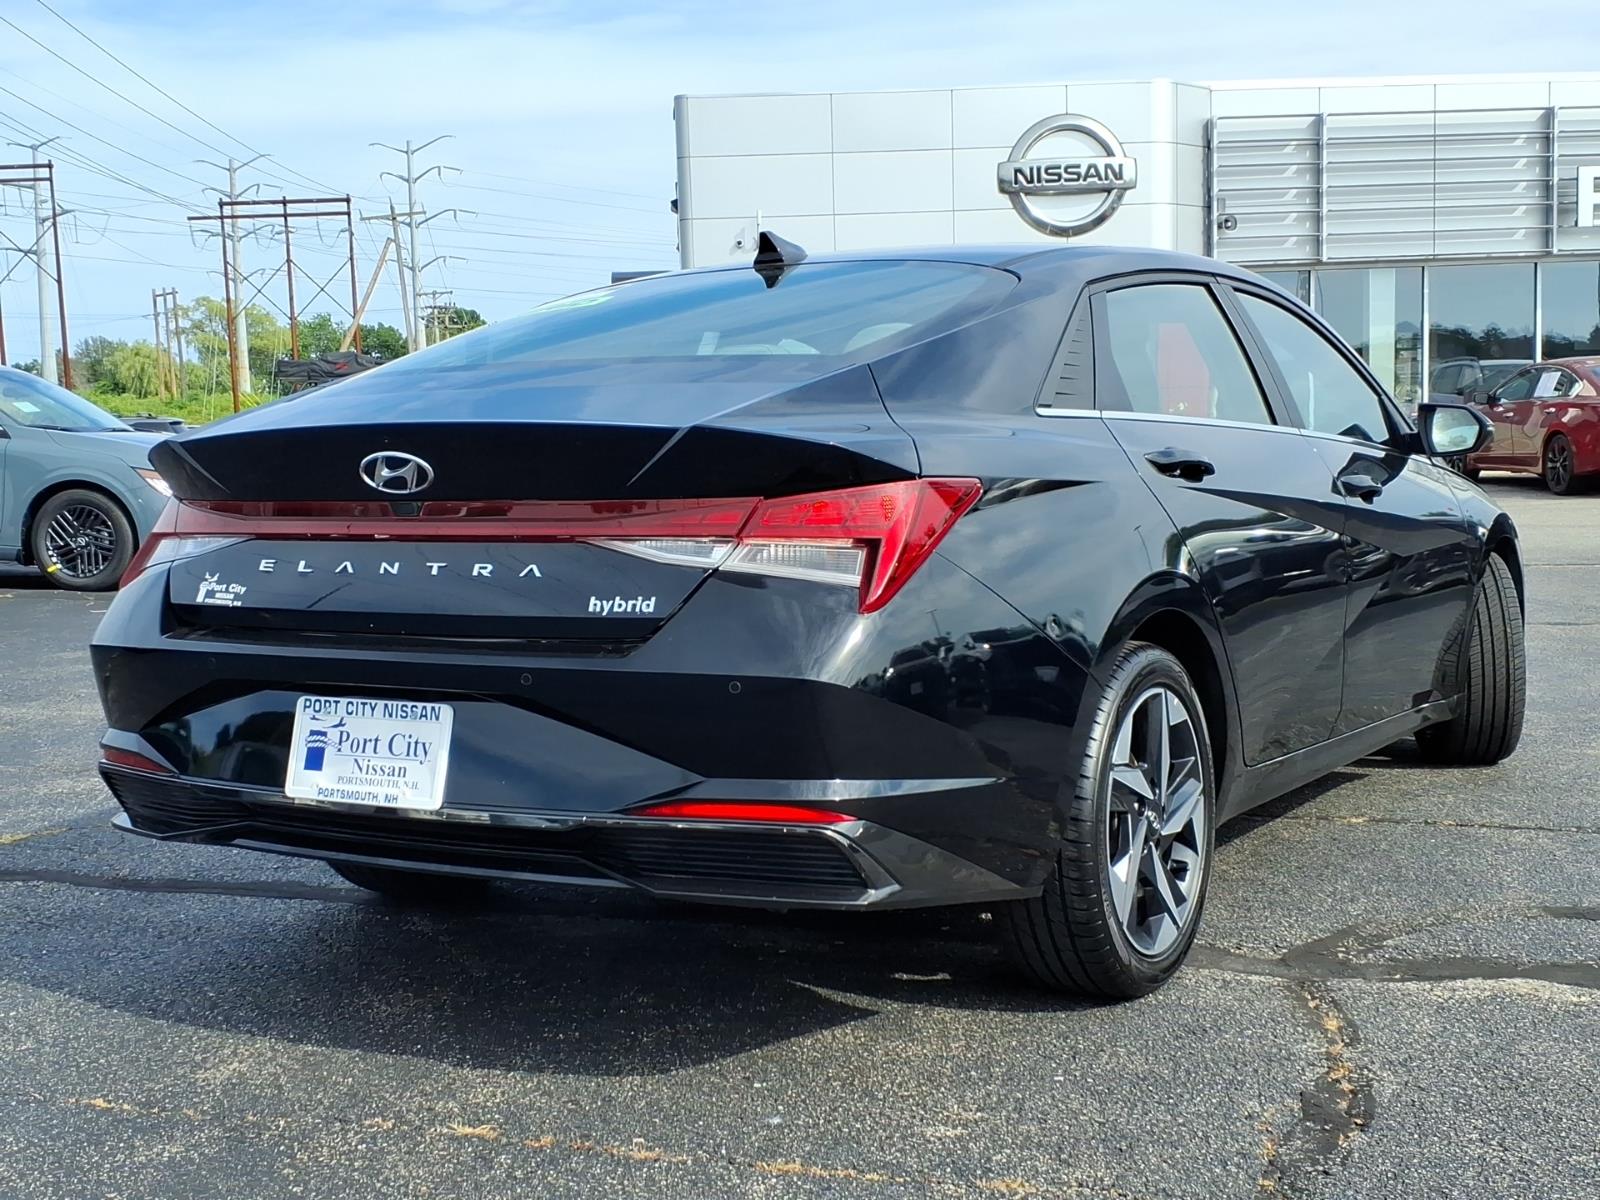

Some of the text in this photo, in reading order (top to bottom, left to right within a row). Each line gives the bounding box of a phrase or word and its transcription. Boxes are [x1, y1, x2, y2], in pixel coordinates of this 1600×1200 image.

[1013, 163, 1124, 186] NISSAN
[258, 559, 543, 578] ELANTRA
[228, 583, 247, 595] City
[588, 596, 656, 615] hybrid
[303, 698, 441, 722] PORT CITY NISSAN
[336, 730, 433, 765] Port City
[351, 758, 407, 779] Nissan
[317, 787, 399, 805] PORTSMOUTH, NH
